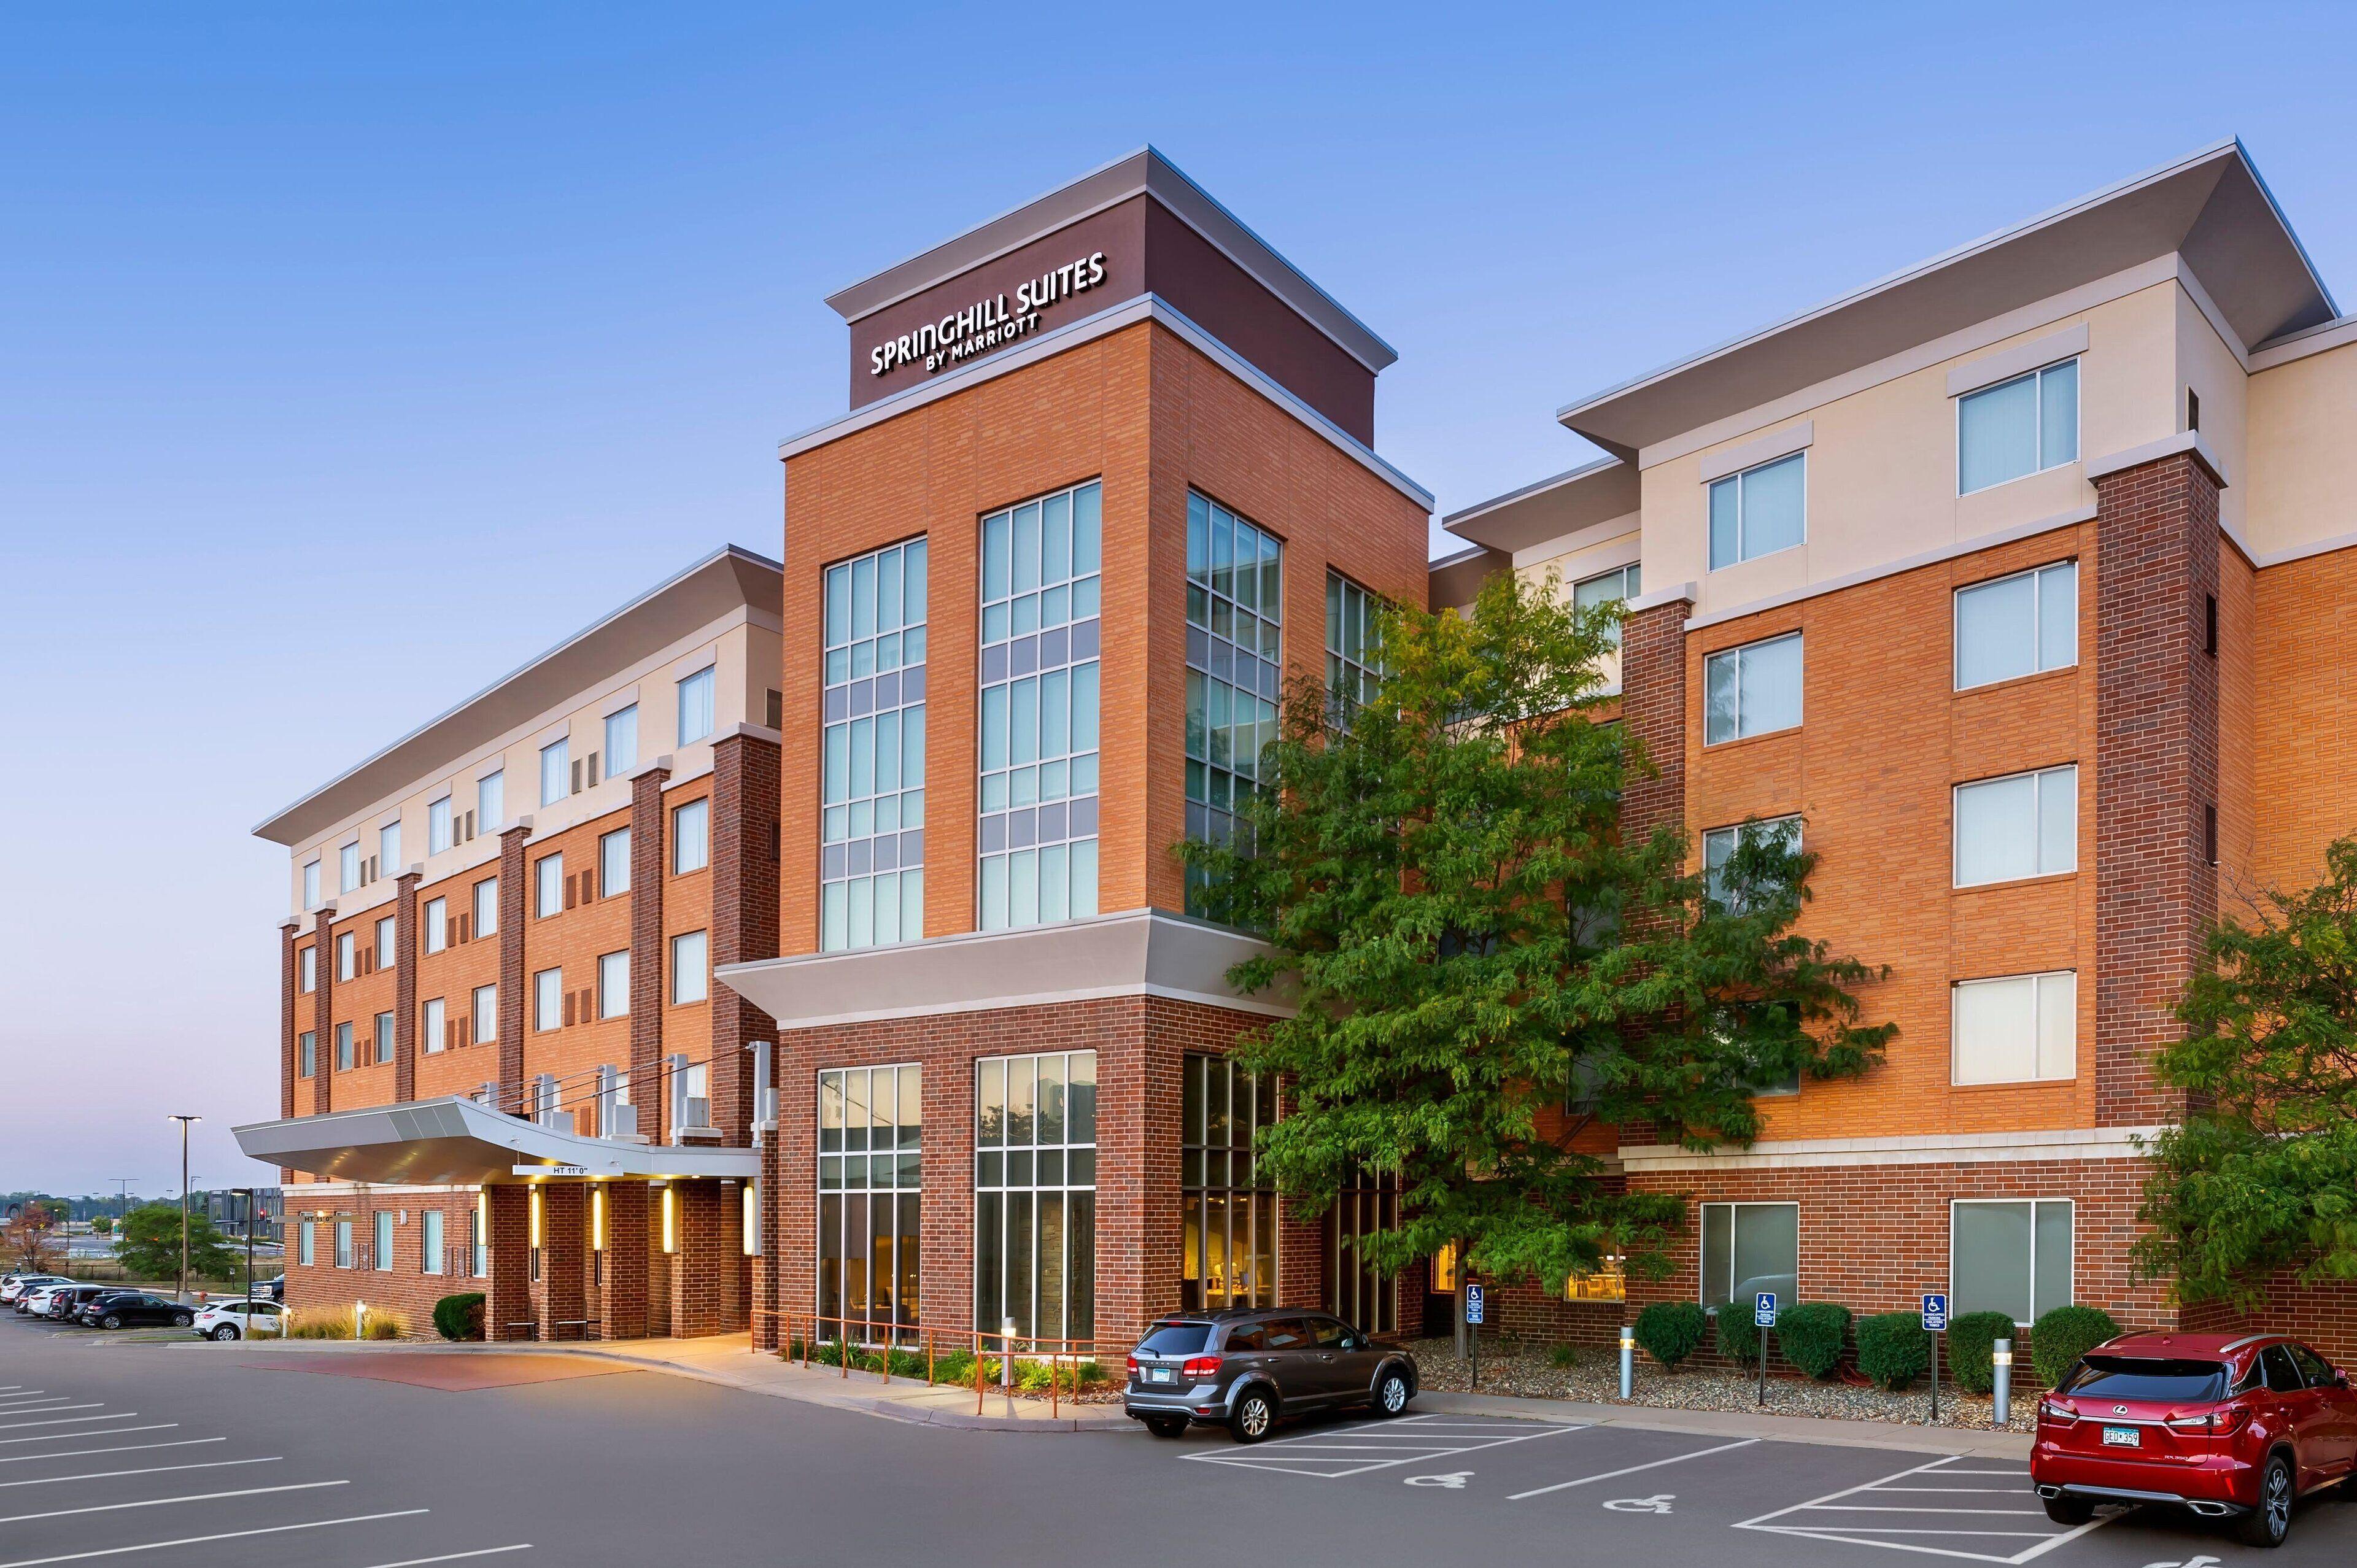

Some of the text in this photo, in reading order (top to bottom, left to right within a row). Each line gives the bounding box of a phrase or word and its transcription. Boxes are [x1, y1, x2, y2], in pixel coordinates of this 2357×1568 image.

[870, 252, 1105, 376] SPRINGHILL SUITES
[926, 312, 1040, 371] BY MARRIOTT
[2124, 1432, 2137, 1442] 359
